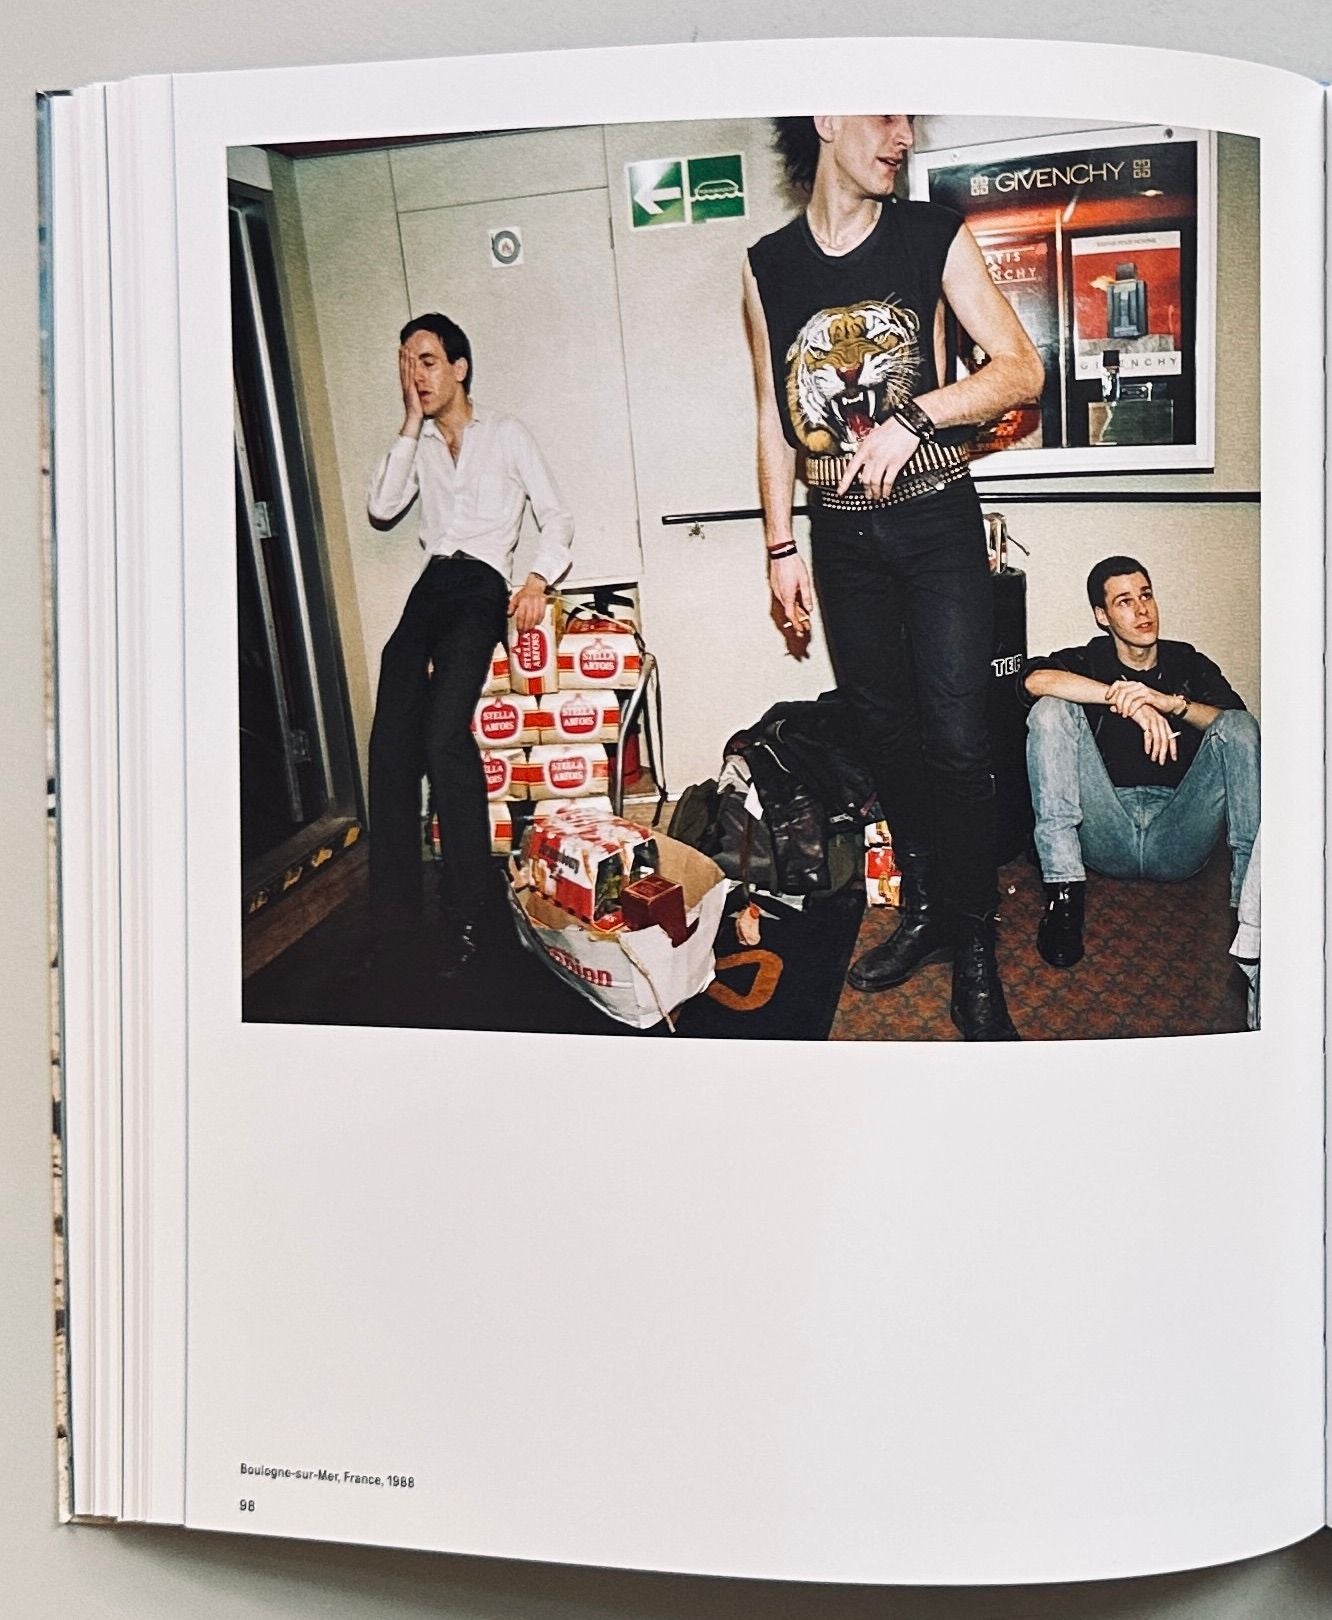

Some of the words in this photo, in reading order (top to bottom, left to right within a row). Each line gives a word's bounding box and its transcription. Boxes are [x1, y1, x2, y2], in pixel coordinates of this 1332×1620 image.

[995, 161, 1125, 192] GIVENCHY
[992, 267, 1036, 280] NCHY
[1080, 358, 1177, 370] GINCHY
[482, 710, 516, 721] STELLA
[563, 716, 595, 727] ARTOIS
[484, 720, 515, 732] ARTOIS
[551, 760, 584, 772] STELLA
[553, 770, 584, 782] ARTOIS
[240, 1463, 341, 1484] Boulogne-sur-Mer,
[344, 1471, 385, 1487] France,
[387, 1475, 415, 1488] 1988
[239, 1499, 256, 1512] 98
